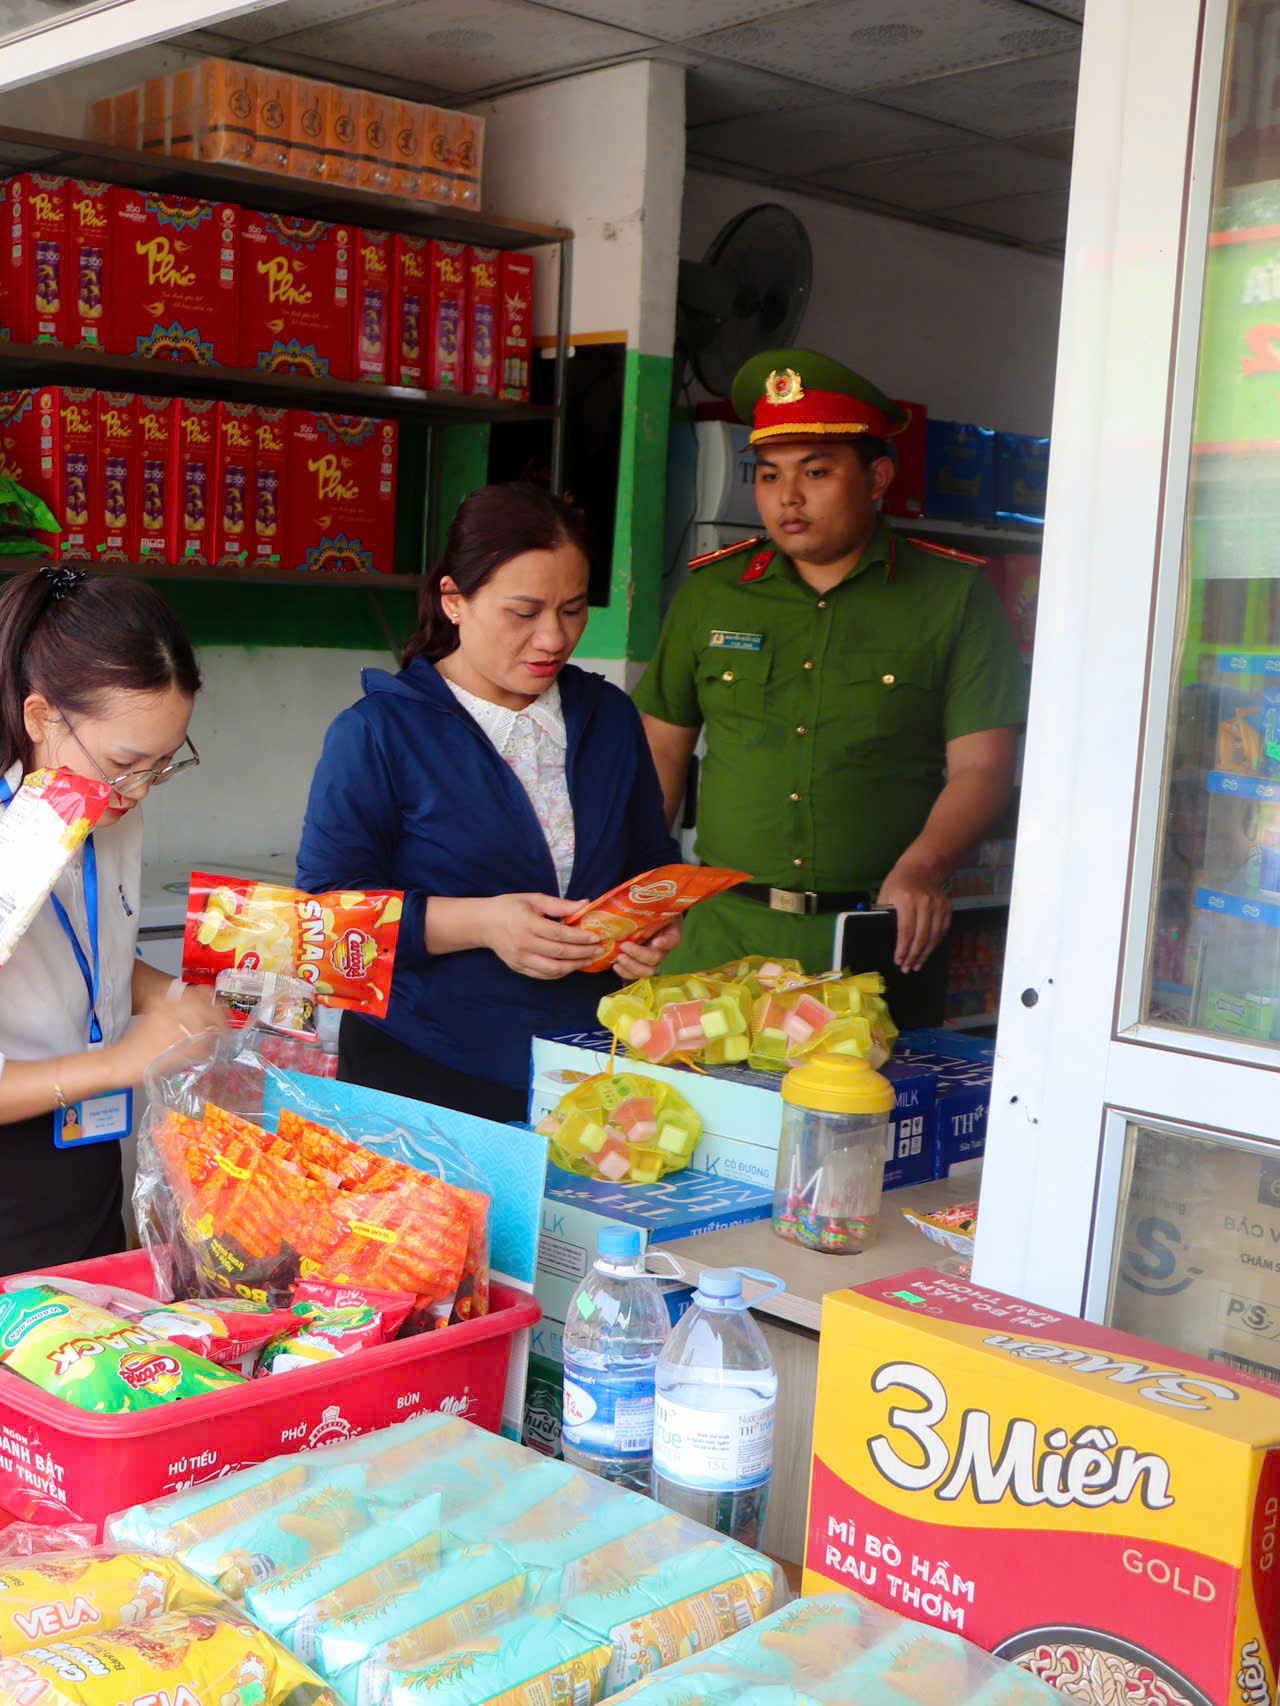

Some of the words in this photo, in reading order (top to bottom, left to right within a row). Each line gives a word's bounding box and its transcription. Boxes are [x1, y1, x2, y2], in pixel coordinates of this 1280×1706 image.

[297, 899, 325, 985] SNAC
[951, 1115, 974, 1136] TH
[679, 1171, 774, 1202] MIL
[542, 1210, 565, 1236] LK
[882, 1291, 943, 1314] GOD
[1007, 1304, 1061, 1324] RAU
[46, 1326, 160, 1376] NACK
[397, 1390, 421, 1409] BÚN
[3, 1425, 29, 1446] NGON
[281, 1422, 308, 1443] PHỞ
[867, 1361, 950, 1491] 3
[935, 1408, 1175, 1509] Miền
[35, 1451, 65, 1483] BẤT
[168, 1456, 188, 1476] HỦ
[190, 1449, 217, 1469] TIẾU
[16, 1464, 67, 1504] TRUYỀN
[1259, 1496, 1279, 1572] GOLD
[827, 1514, 856, 1547] MÌ
[864, 1535, 903, 1569] BÒ
[911, 1554, 976, 1604] HẦM
[1122, 1548, 1216, 1602] GOLD
[825, 1545, 877, 1586] RAU
[886, 1573, 966, 1630] THƠM
[14, 1595, 100, 1641] VELA
